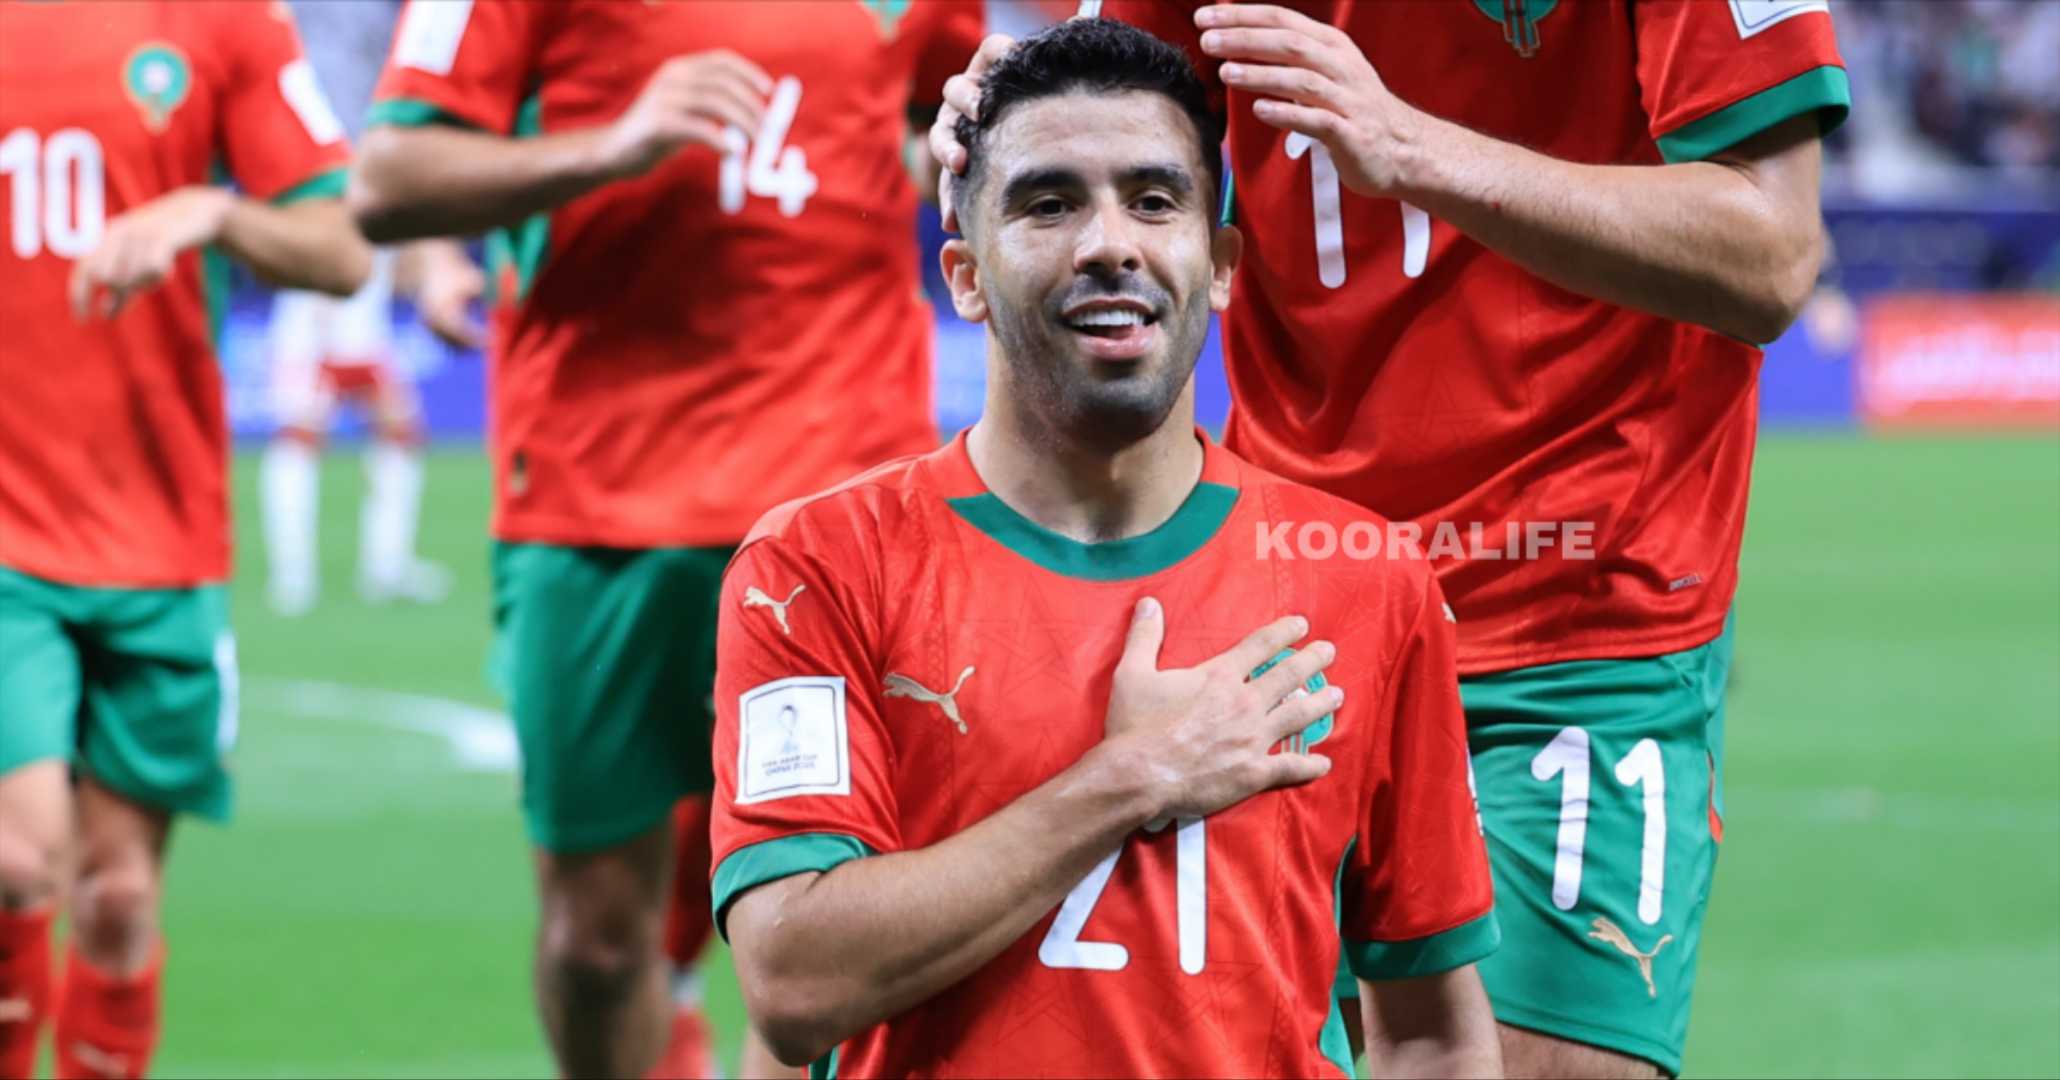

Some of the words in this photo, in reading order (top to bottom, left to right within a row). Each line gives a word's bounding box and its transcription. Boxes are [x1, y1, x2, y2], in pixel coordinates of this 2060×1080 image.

[0, 126, 104, 260] 10
[719, 73, 820, 218] 14
[1530, 725, 1667, 926] 11
